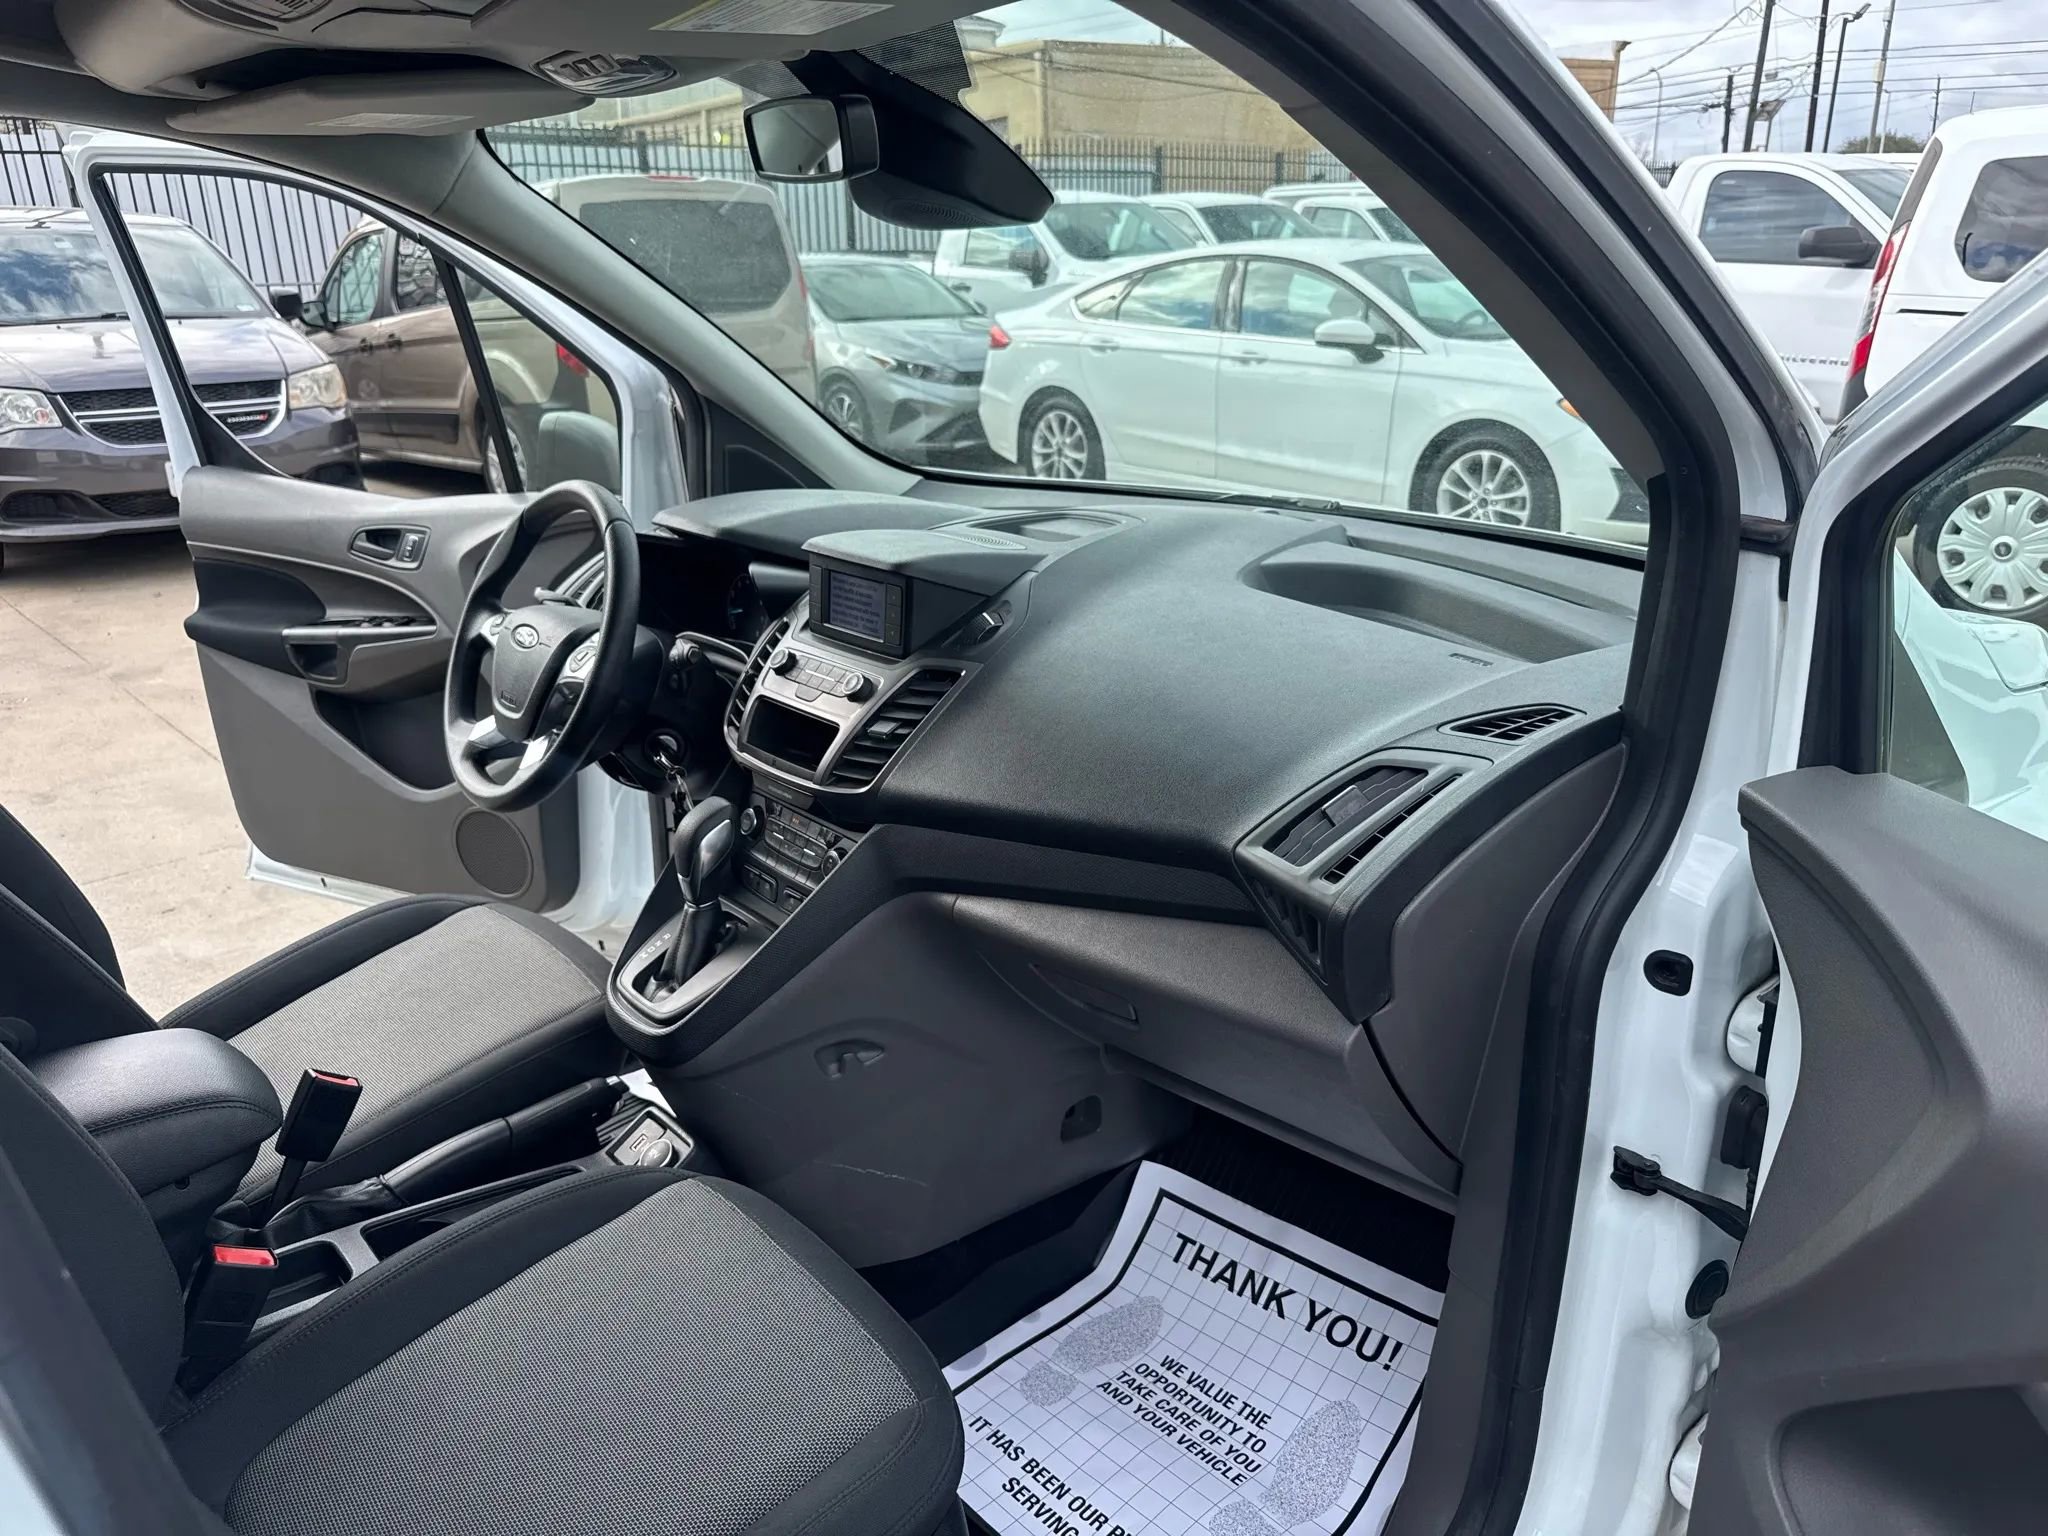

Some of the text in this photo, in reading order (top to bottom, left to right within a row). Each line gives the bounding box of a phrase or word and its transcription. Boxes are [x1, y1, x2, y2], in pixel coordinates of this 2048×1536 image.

[1173, 1232, 1403, 1371] THANK YOU!
[1096, 1381, 1248, 1486] AND YOUR VEHICLE
[1116, 1370, 1262, 1473] TAKE CARE OF YOU
[1134, 1363, 1267, 1453] OPPORTUNITY TO
[1160, 1355, 1272, 1430] WE VALUE THE
[968, 1416, 993, 1433] IT
[985, 1429, 1025, 1461] HAS
[1020, 1457, 1072, 1500] BEEN
[1068, 1496, 1109, 1531] OUR
[1002, 1477, 1079, 1536] SERVING
